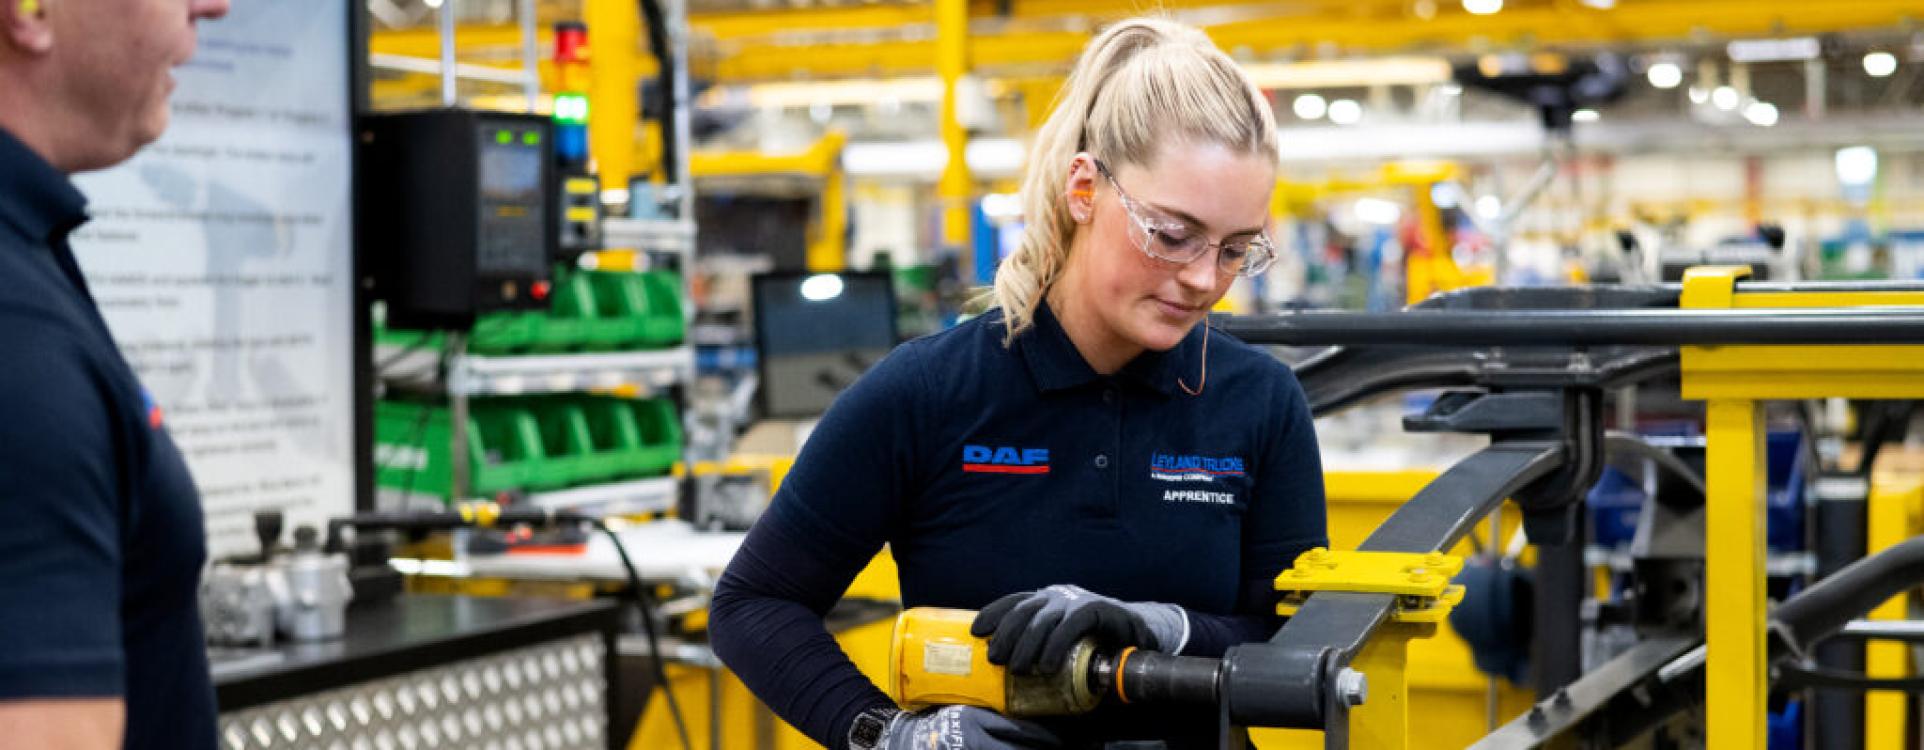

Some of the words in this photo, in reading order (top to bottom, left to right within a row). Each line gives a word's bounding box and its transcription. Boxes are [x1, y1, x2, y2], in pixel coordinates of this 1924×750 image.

[963, 445, 1049, 465] DAF
[1151, 454, 1201, 470] LEYLAND
[1202, 458, 1244, 472] TRUCKS
[1163, 490, 1234, 504] APPRENTICE
